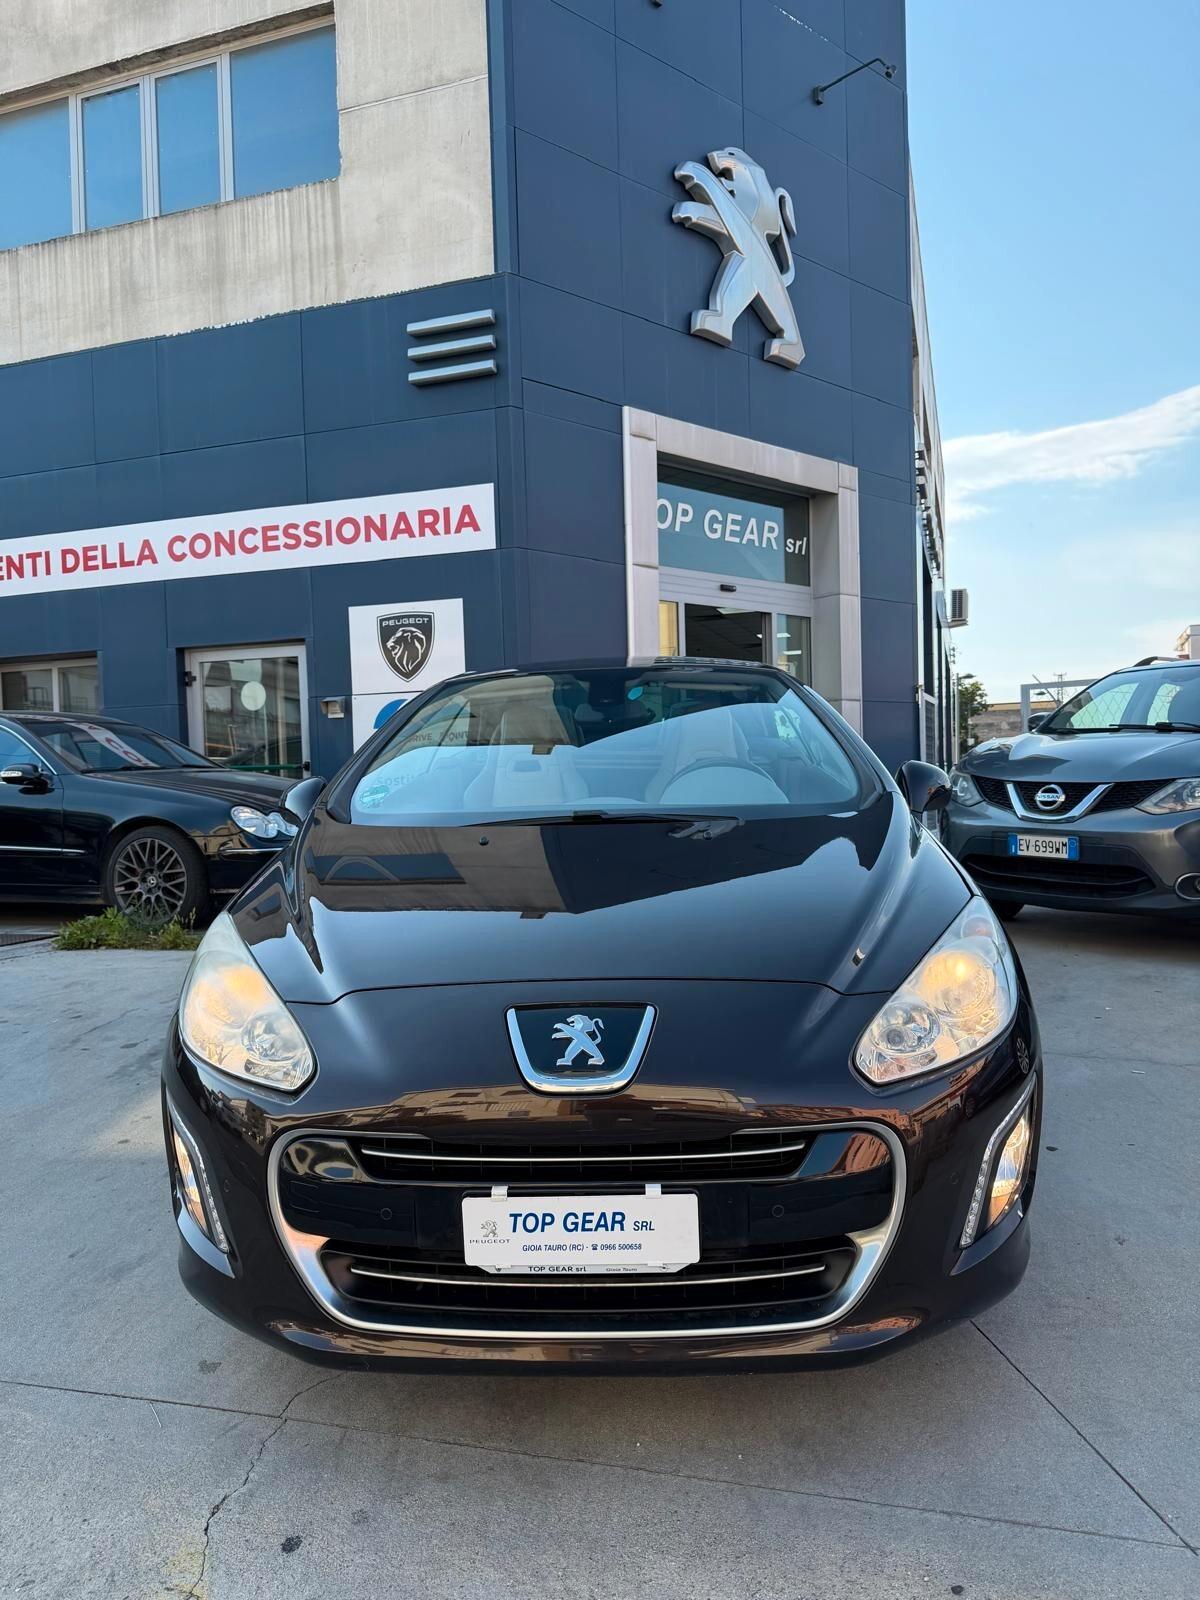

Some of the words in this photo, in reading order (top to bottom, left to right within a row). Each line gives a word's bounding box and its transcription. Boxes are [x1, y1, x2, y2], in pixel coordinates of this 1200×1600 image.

[61, 538, 158, 574] DELLA
[167, 504, 481, 562] CONCESSIONARIA
[703, 509, 780, 550] GEAR
[785, 537, 807, 555] srl
[382, 617, 430, 627] PEUGEOT
[1018, 838, 1031, 852] EV
[1034, 839, 1068, 854] 699WM
[509, 1212, 555, 1233] TOP
[562, 1211, 626, 1232] GEAR
[633, 1220, 655, 1231] SRL
[522, 1244, 543, 1252] GIOIA
[544, 1244, 567, 1252] TAURO
[568, 1243, 585, 1253] (RC)
[600, 1243, 617, 1251] 0966
[618, 1243, 642, 1251] 500658
[575, 1265, 587, 1273] srl
